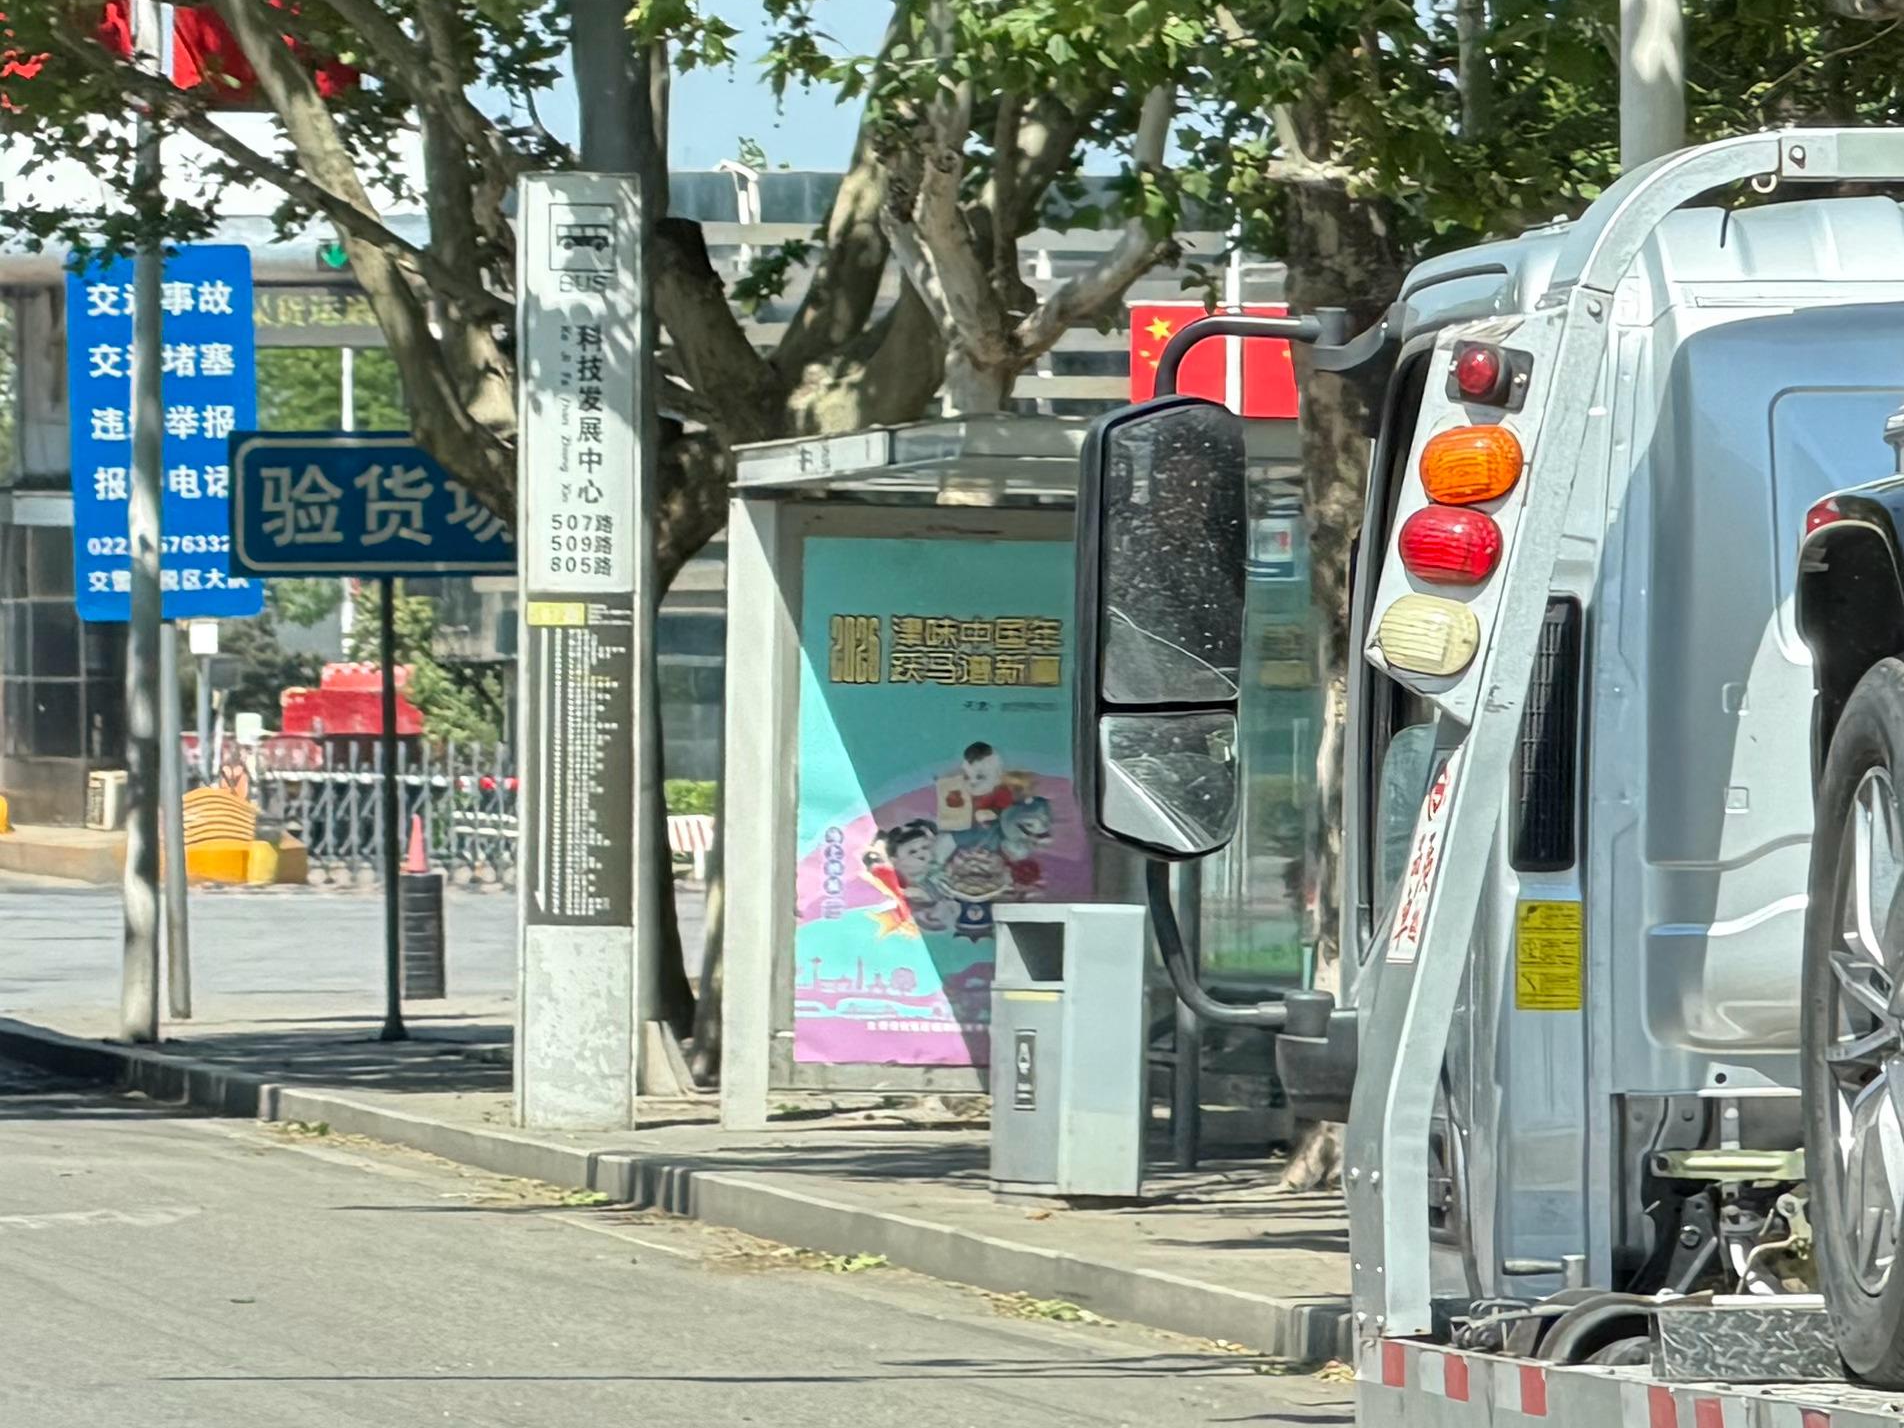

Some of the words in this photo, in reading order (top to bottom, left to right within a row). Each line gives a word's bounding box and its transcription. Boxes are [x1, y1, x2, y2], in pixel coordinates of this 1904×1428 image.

[560, 274, 608, 293] BUS
[90, 405, 236, 441] 违举报
[576, 324, 604, 505] 科技发展中心
[93, 465, 229, 500] 报电话
[551, 514, 614, 535] 507路
[551, 535, 613, 556] 509路
[550, 556, 613, 577] 805路
